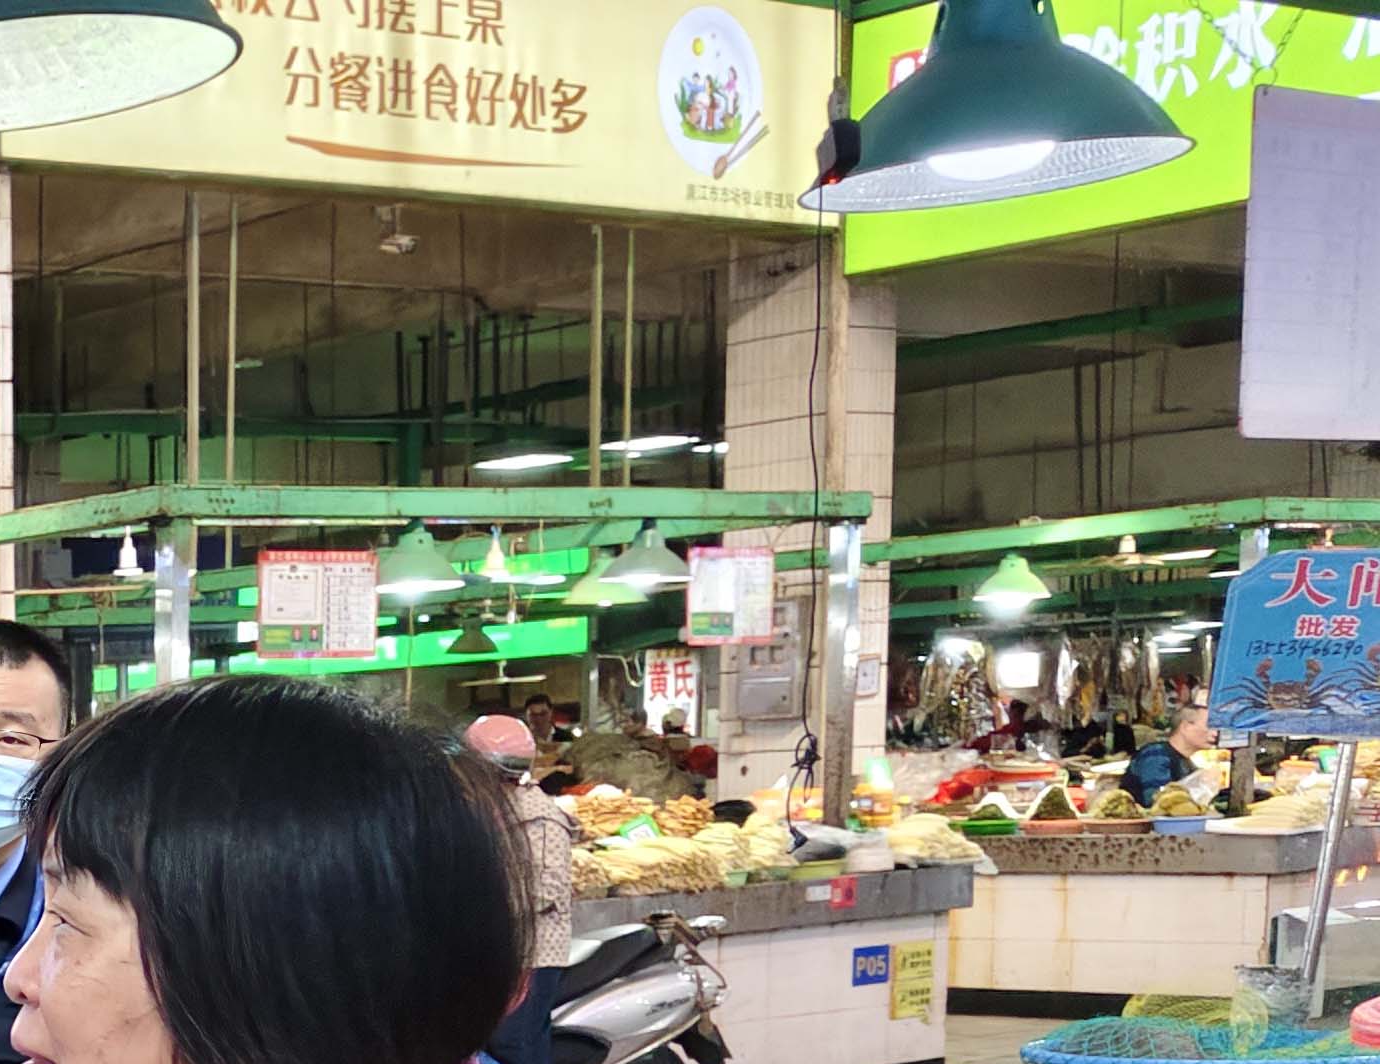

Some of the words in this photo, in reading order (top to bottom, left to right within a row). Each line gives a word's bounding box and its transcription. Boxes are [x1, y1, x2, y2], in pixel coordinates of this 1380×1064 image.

[284, 46, 588, 134] 分餐进食好处多
[1294, 614, 1361, 639] 批发
[648, 659, 695, 702] 黄氏
[855, 954, 887, 979] P05
